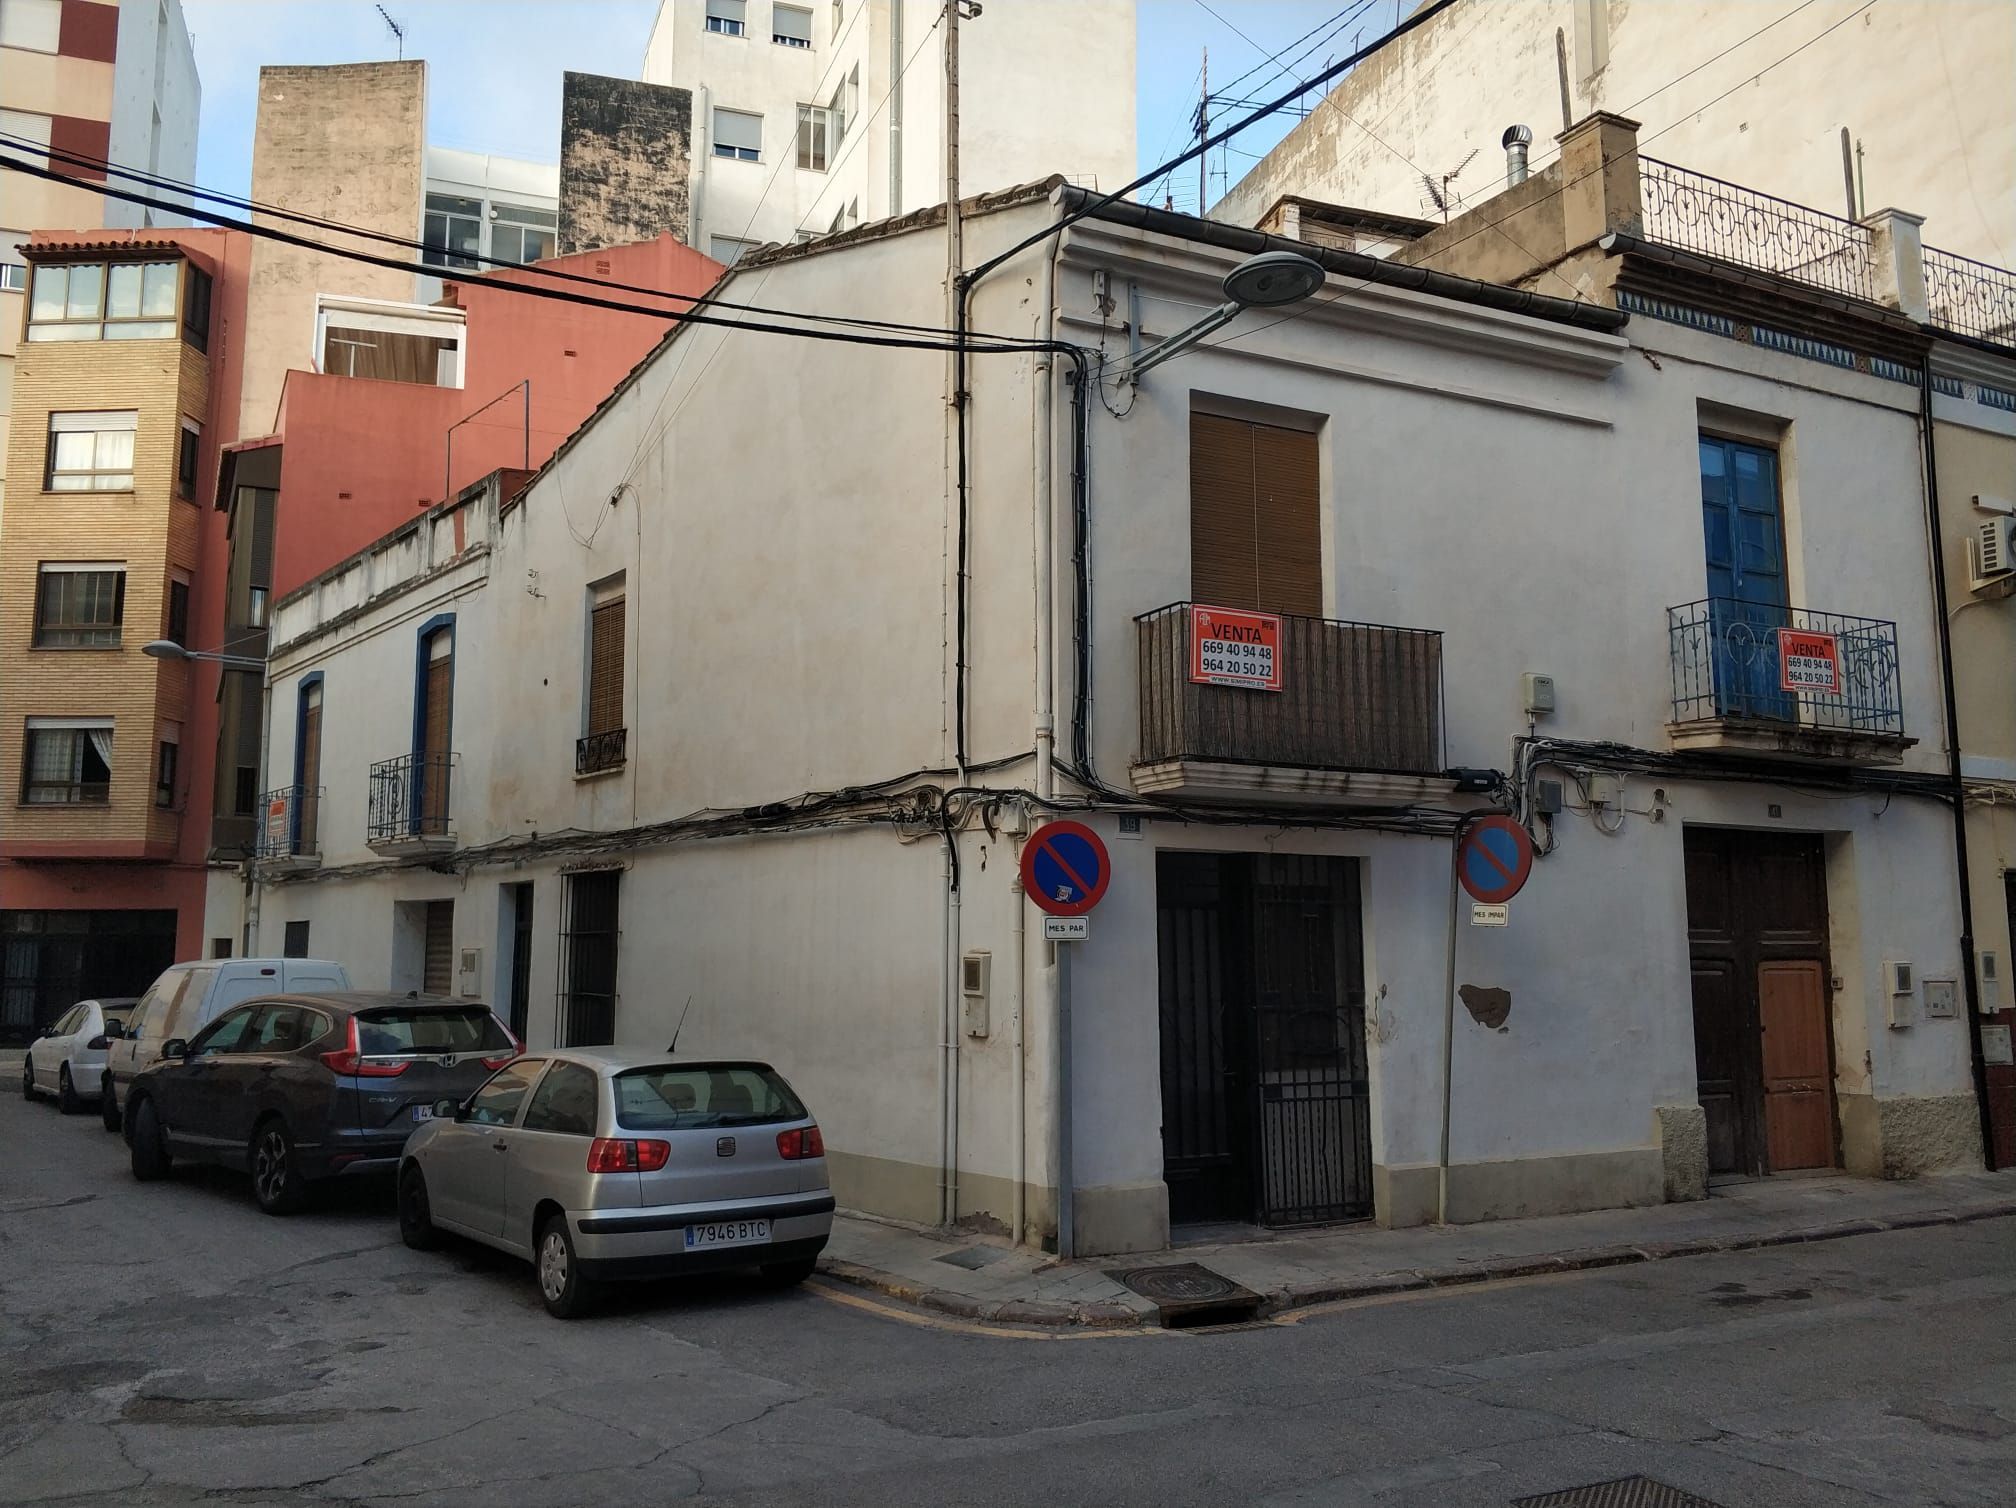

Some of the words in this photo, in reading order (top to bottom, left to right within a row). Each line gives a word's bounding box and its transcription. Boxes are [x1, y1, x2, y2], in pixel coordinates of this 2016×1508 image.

[1210, 622, 1262, 643] VENTA
[1202, 641, 1224, 654] 669
[1226, 643, 1240, 656] 40
[1243, 645, 1256, 658] 94
[1258, 647, 1272, 660] 48
[1791, 643, 1825, 658] VENTA
[1202, 658, 1224, 672] 964
[1226, 660, 1240, 673] 20
[1243, 662, 1256, 675] 50
[1259, 665, 1272, 677] 22
[1788, 656, 1801, 667] 669
[1803, 658, 1811, 669] 40
[1813, 659, 1823, 669] 94
[1823, 660, 1832, 670] 48
[1788, 671, 1802, 681] 964
[1804, 672, 1813, 682] 20
[1814, 673, 1824, 683] 50
[1825, 674, 1833, 684] 22
[697, 1224, 735, 1242] 7946
[739, 1221, 766, 1238] BTC
